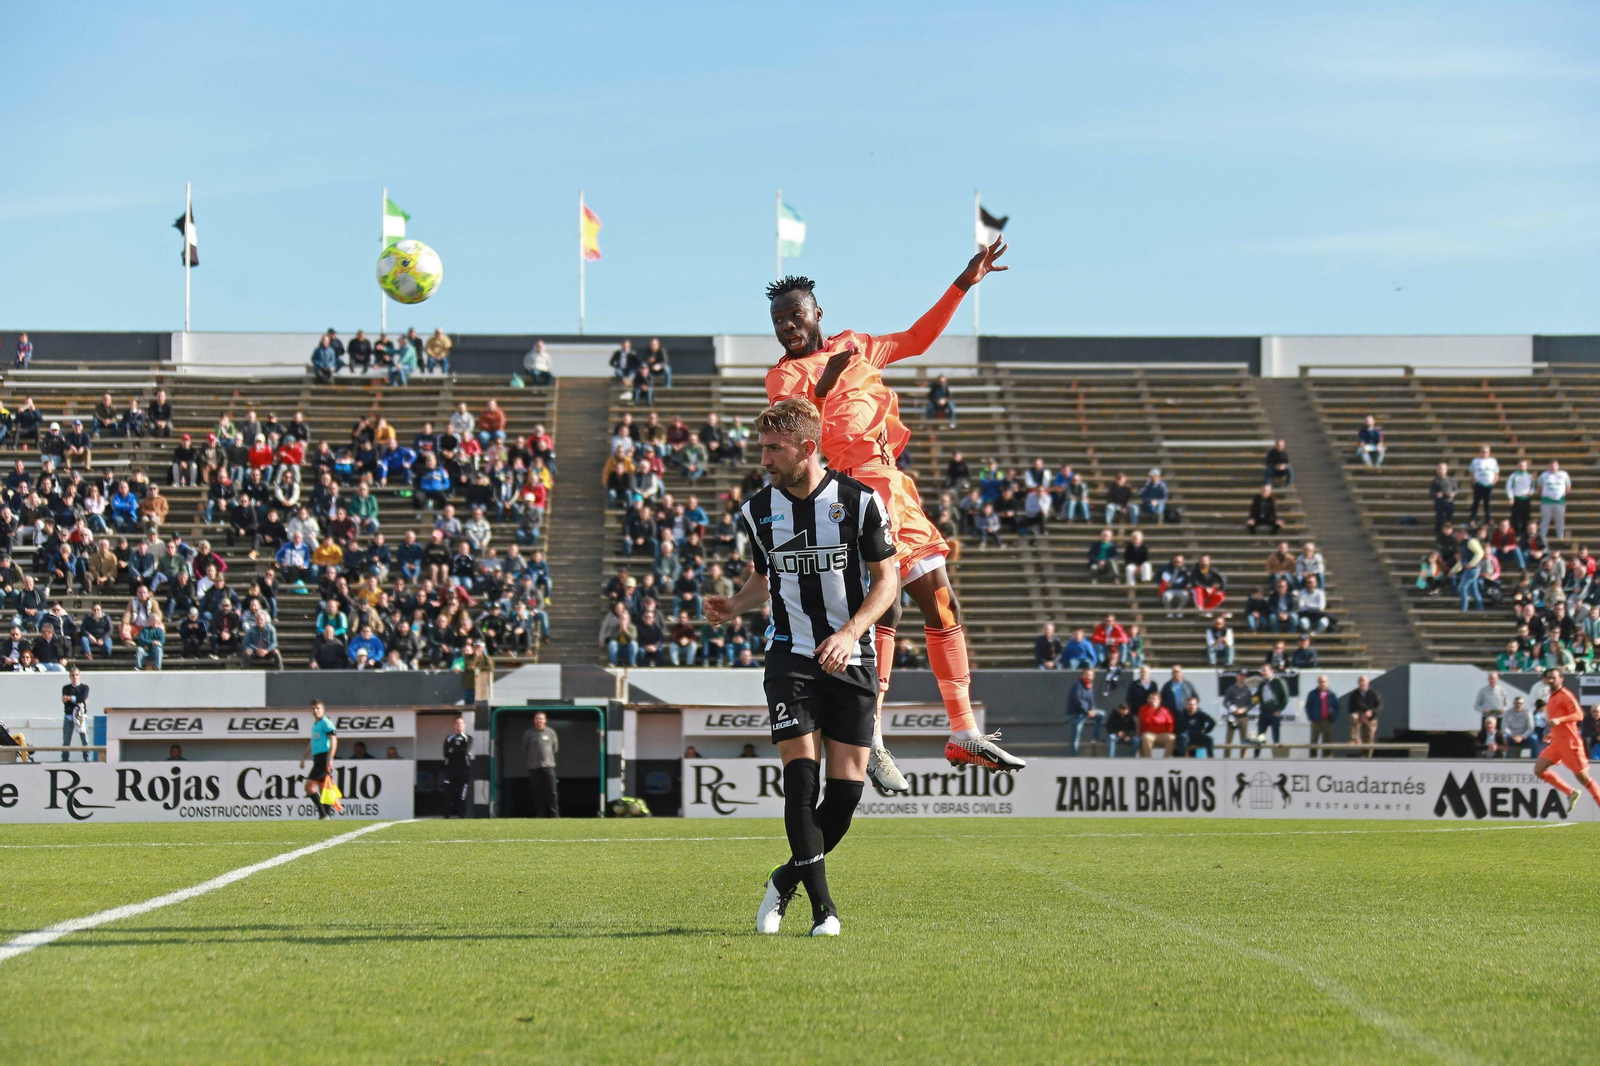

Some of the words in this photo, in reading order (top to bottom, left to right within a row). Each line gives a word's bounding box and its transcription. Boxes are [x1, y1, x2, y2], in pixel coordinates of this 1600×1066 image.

[760, 513, 785, 525] LEGEA
[769, 549, 848, 575] LOTUS
[775, 702, 789, 721] 2
[128, 717, 204, 732] LEGEA
[227, 717, 300, 731] LEGEA
[335, 716, 395, 730] EGEA
[772, 718, 799, 731] LEGEA
[890, 714, 951, 728] LEGE
[115, 766, 220, 811] Rojas
[1055, 776, 1129, 812] ZABAL
[1135, 769, 1217, 813] BAÑOS
[1291, 774, 1311, 793] El
[1316, 775, 1426, 795] Guadarnés
[179, 804, 283, 819] CONSTRUCCIONES
[286, 804, 294, 817] Y
[923, 803, 929, 815] Y
[934, 802, 970, 815] OBRAS
[973, 802, 1013, 815] CIVILES
[1305, 802, 1411, 811] RESTAURANTE
